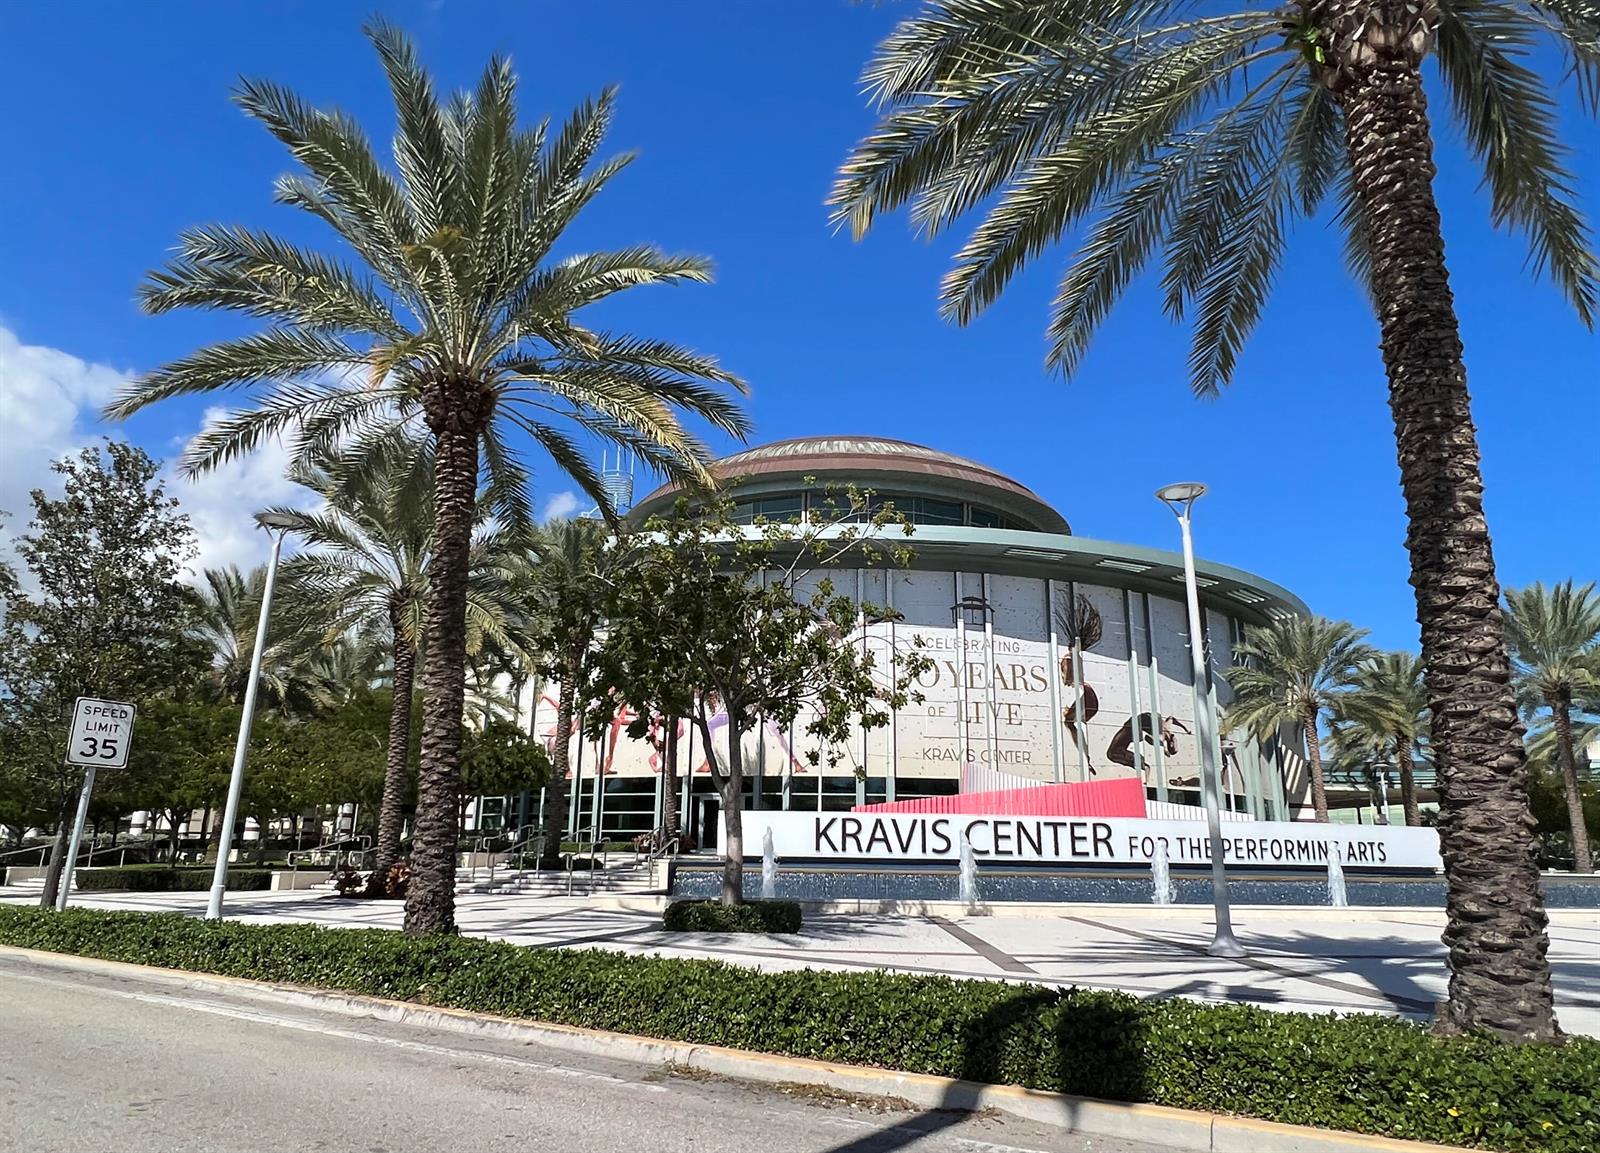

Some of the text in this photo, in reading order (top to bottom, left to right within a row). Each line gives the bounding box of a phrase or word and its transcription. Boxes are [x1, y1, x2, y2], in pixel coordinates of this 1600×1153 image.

[926, 637, 1020, 653] CELEBRAING
[943, 660, 1048, 692] YEARS
[84, 705, 128, 719] SPEED
[927, 700, 1023, 726] OF LIVE
[86, 721, 120, 733] LIMIT
[79, 737, 118, 759] 35
[922, 748, 976, 763] KRAVS
[815, 817, 951, 854] KRAVIS
[965, 820, 1115, 857] CENTER
[1176, 837, 1212, 859] THE
[1347, 841, 1387, 863] ARTS
